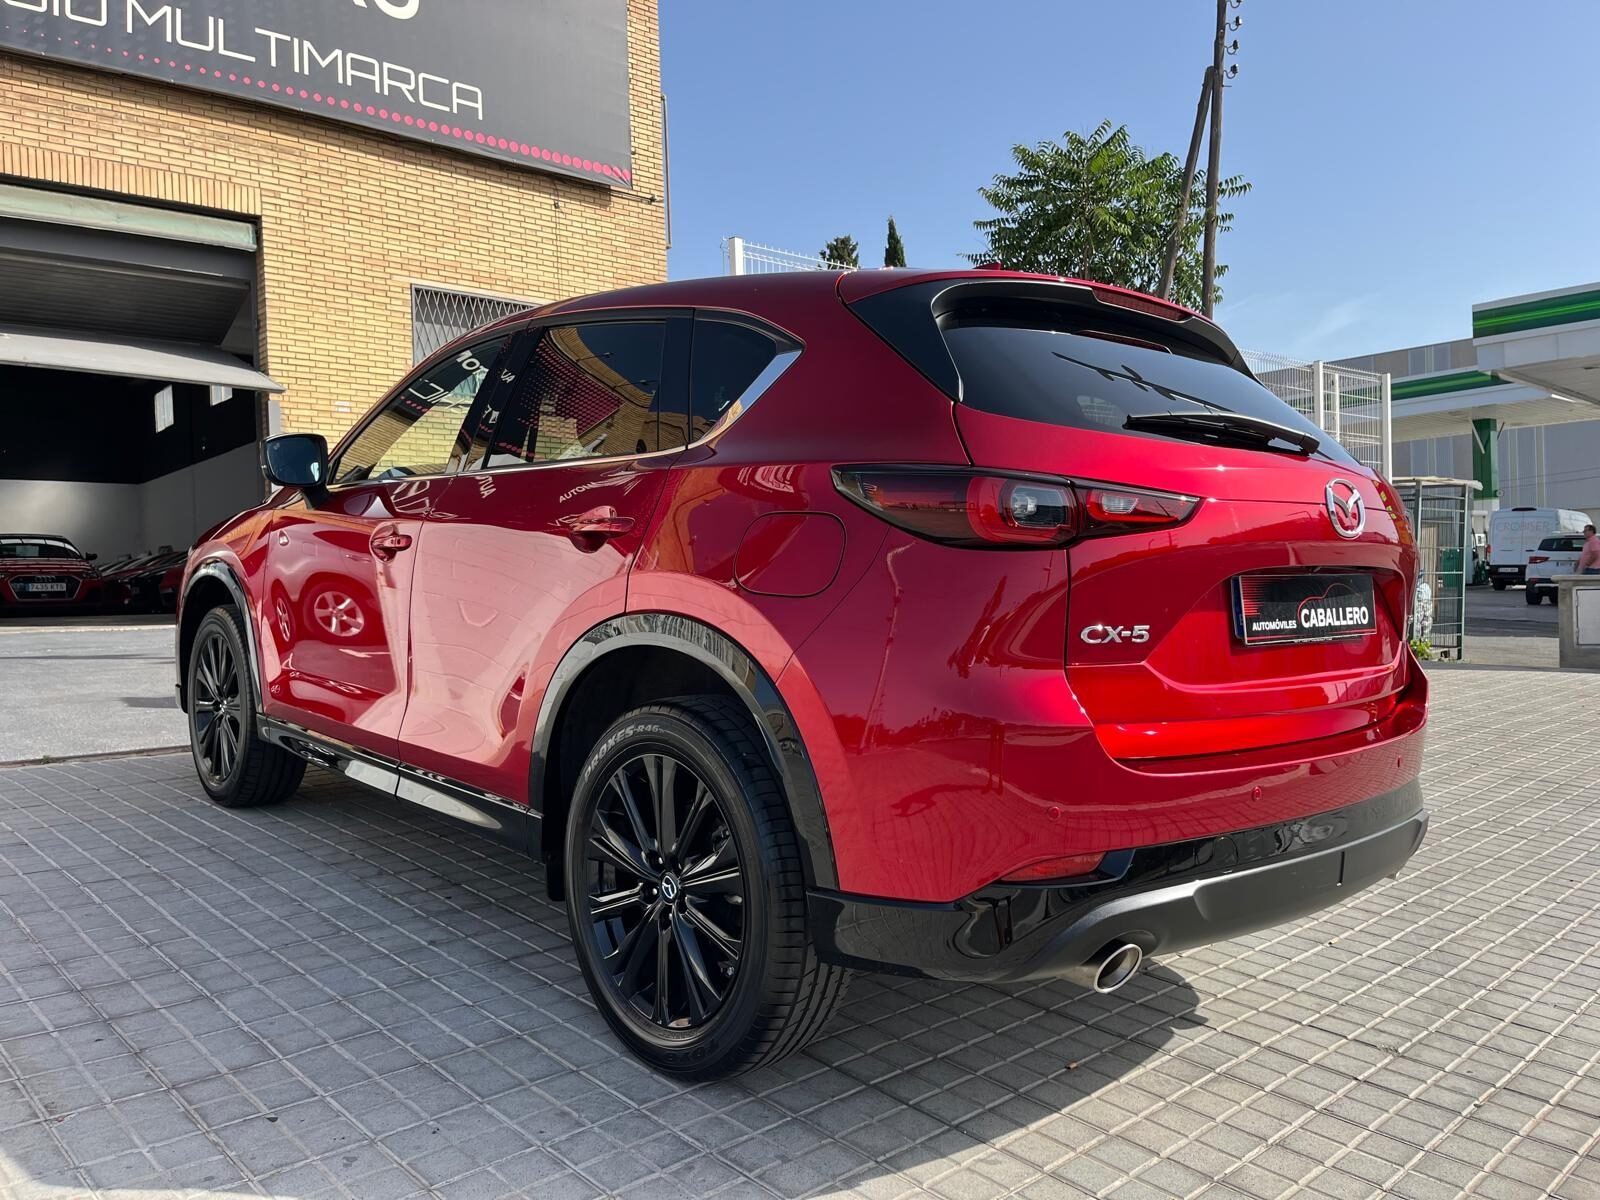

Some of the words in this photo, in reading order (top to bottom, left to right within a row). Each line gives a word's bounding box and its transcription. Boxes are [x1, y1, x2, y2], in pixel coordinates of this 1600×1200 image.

[126, 0, 483, 121] MULTIMARCA
[1252, 619, 1297, 631] AUTOMÓVILES
[1302, 606, 1369, 628] CABALLERO
[1081, 624, 1150, 644] CX-5
